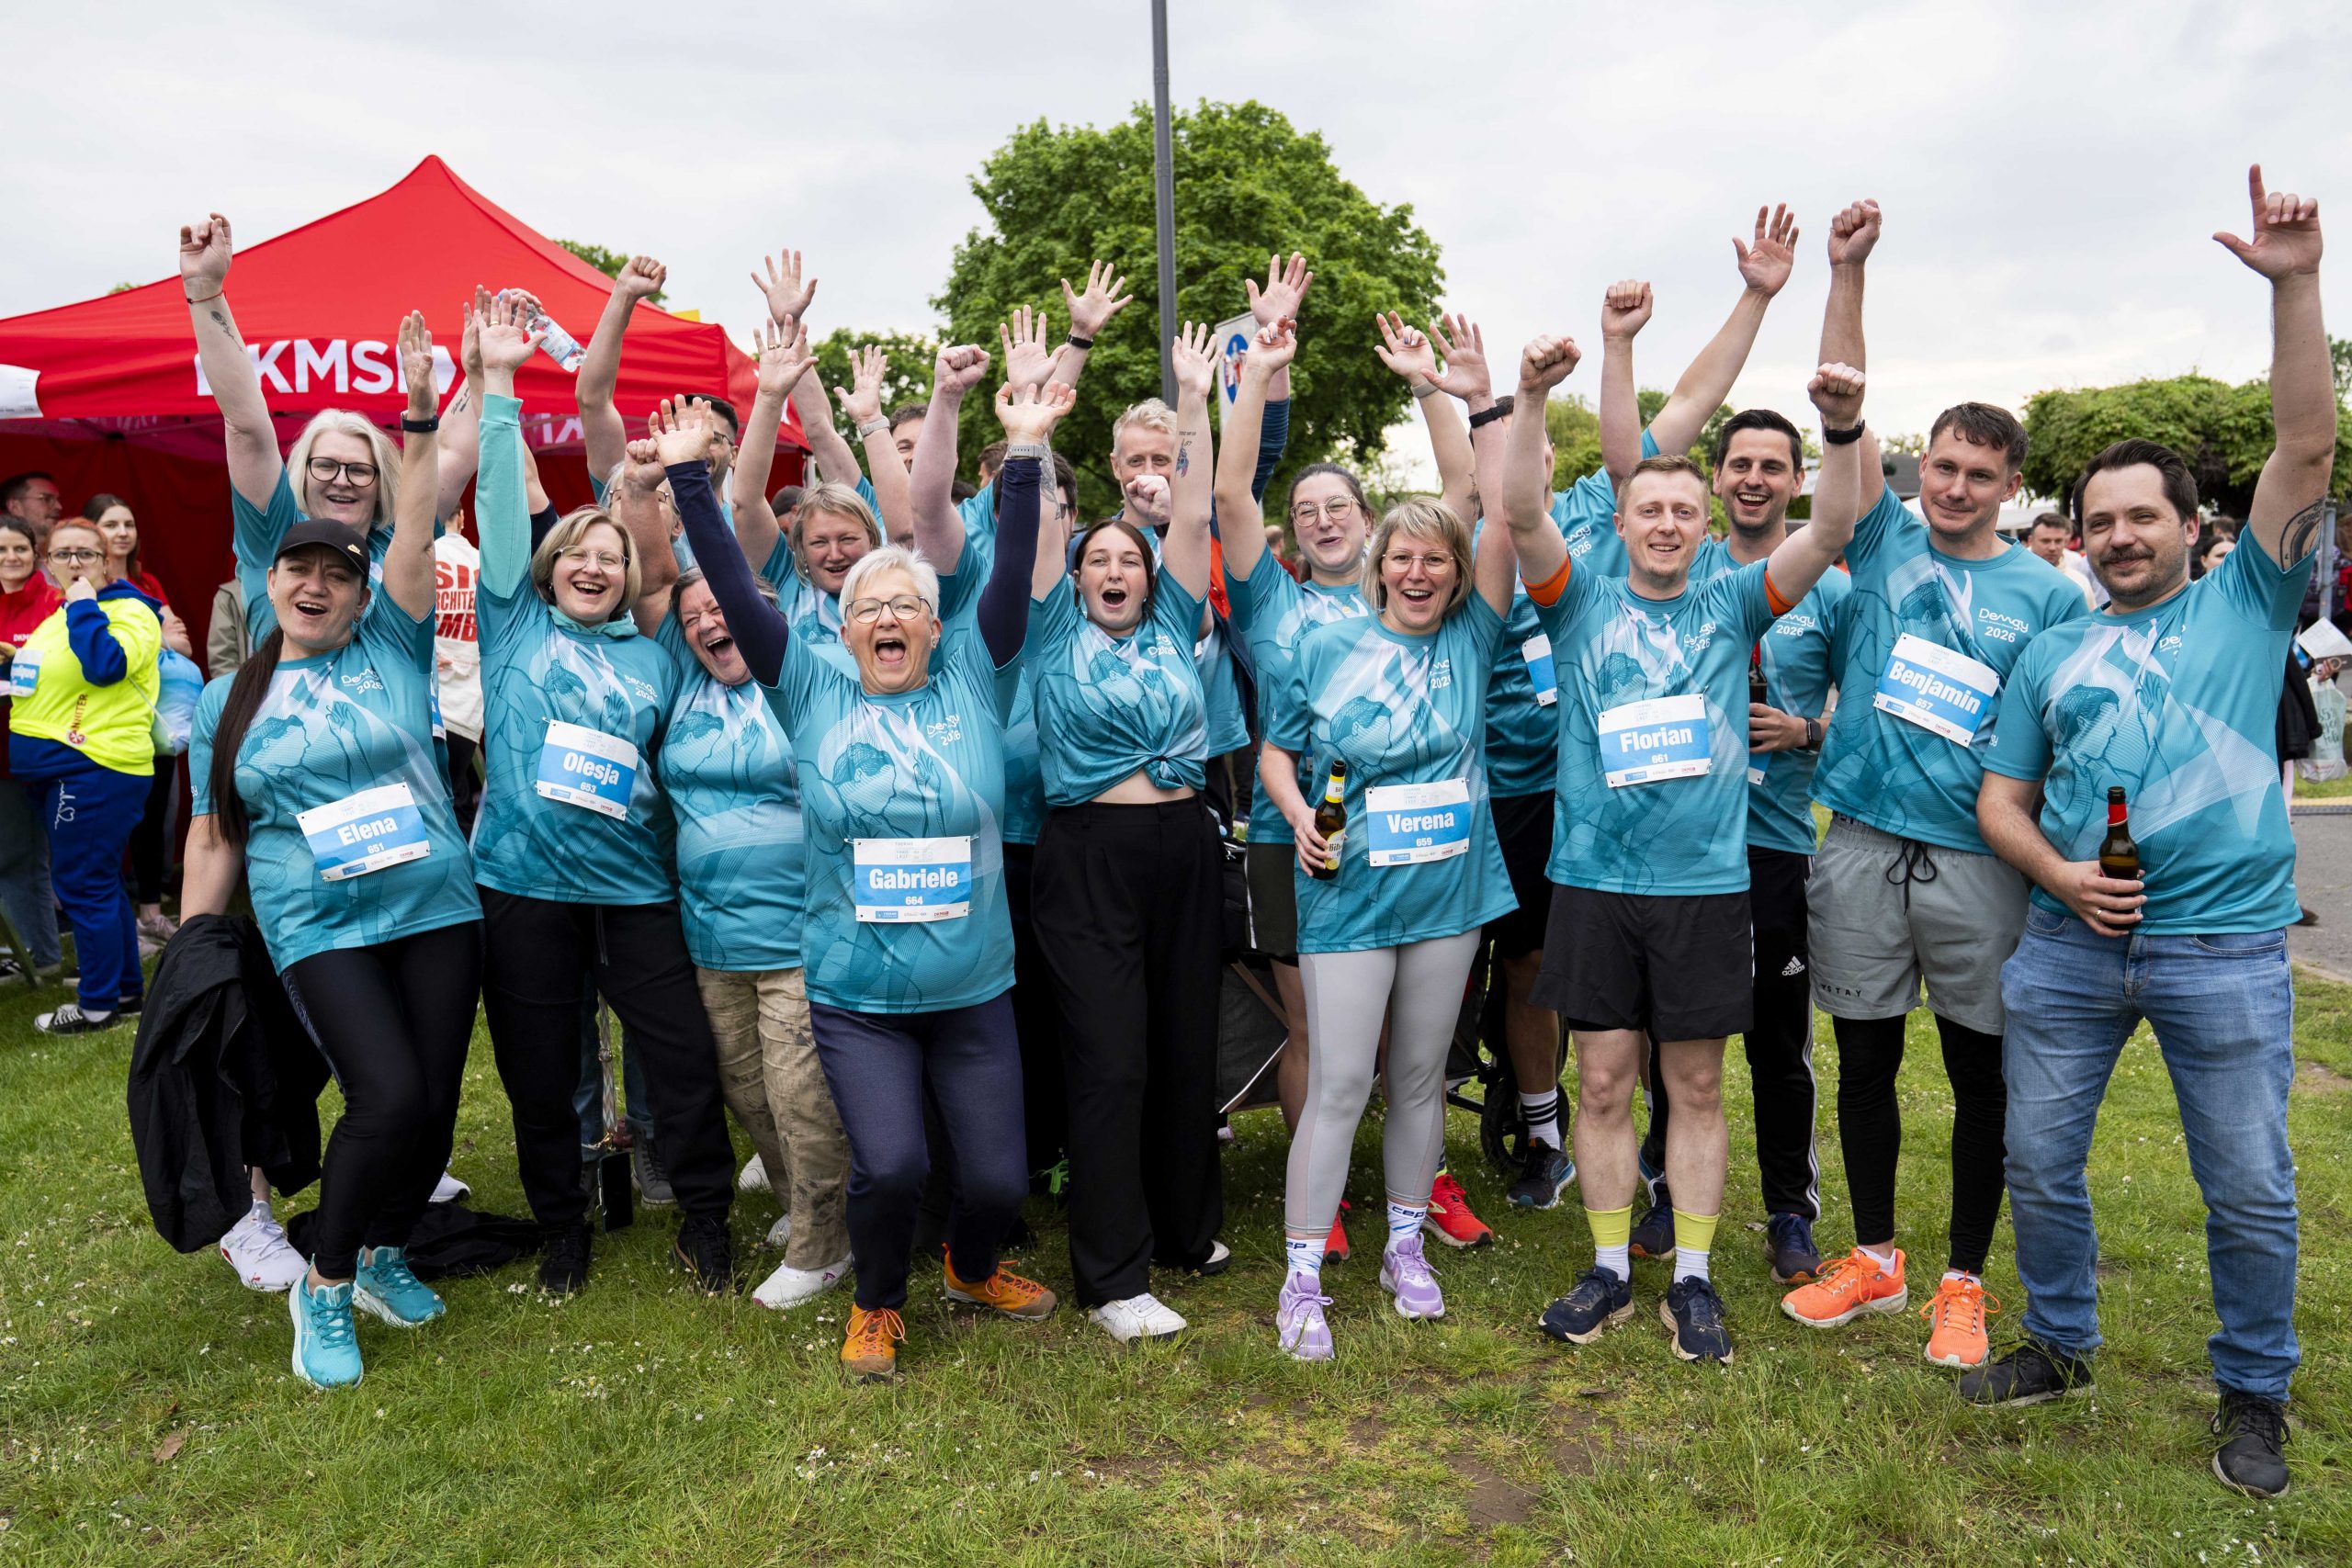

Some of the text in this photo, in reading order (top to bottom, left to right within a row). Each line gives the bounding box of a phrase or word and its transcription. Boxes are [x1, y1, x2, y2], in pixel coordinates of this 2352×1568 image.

[1779, 613, 1815, 628] emgy
[1775, 624, 1804, 637] 2026
[1984, 626, 2017, 643] 2026
[1888, 660, 1981, 715] Benjamin
[1915, 697, 1934, 711] 657
[1620, 726, 1693, 753] Florian
[563, 751, 620, 785] Olesja
[580, 782, 596, 794] 653
[1386, 811, 1454, 834] Verena
[337, 817, 399, 846] Elena
[367, 842, 385, 854] 651
[1416, 837, 1433, 847] 659
[869, 867, 958, 889] Gabriele
[905, 896, 923, 906] 664
[1781, 964, 1805, 976] adidas
[1392, 1205, 1424, 1219] cep
